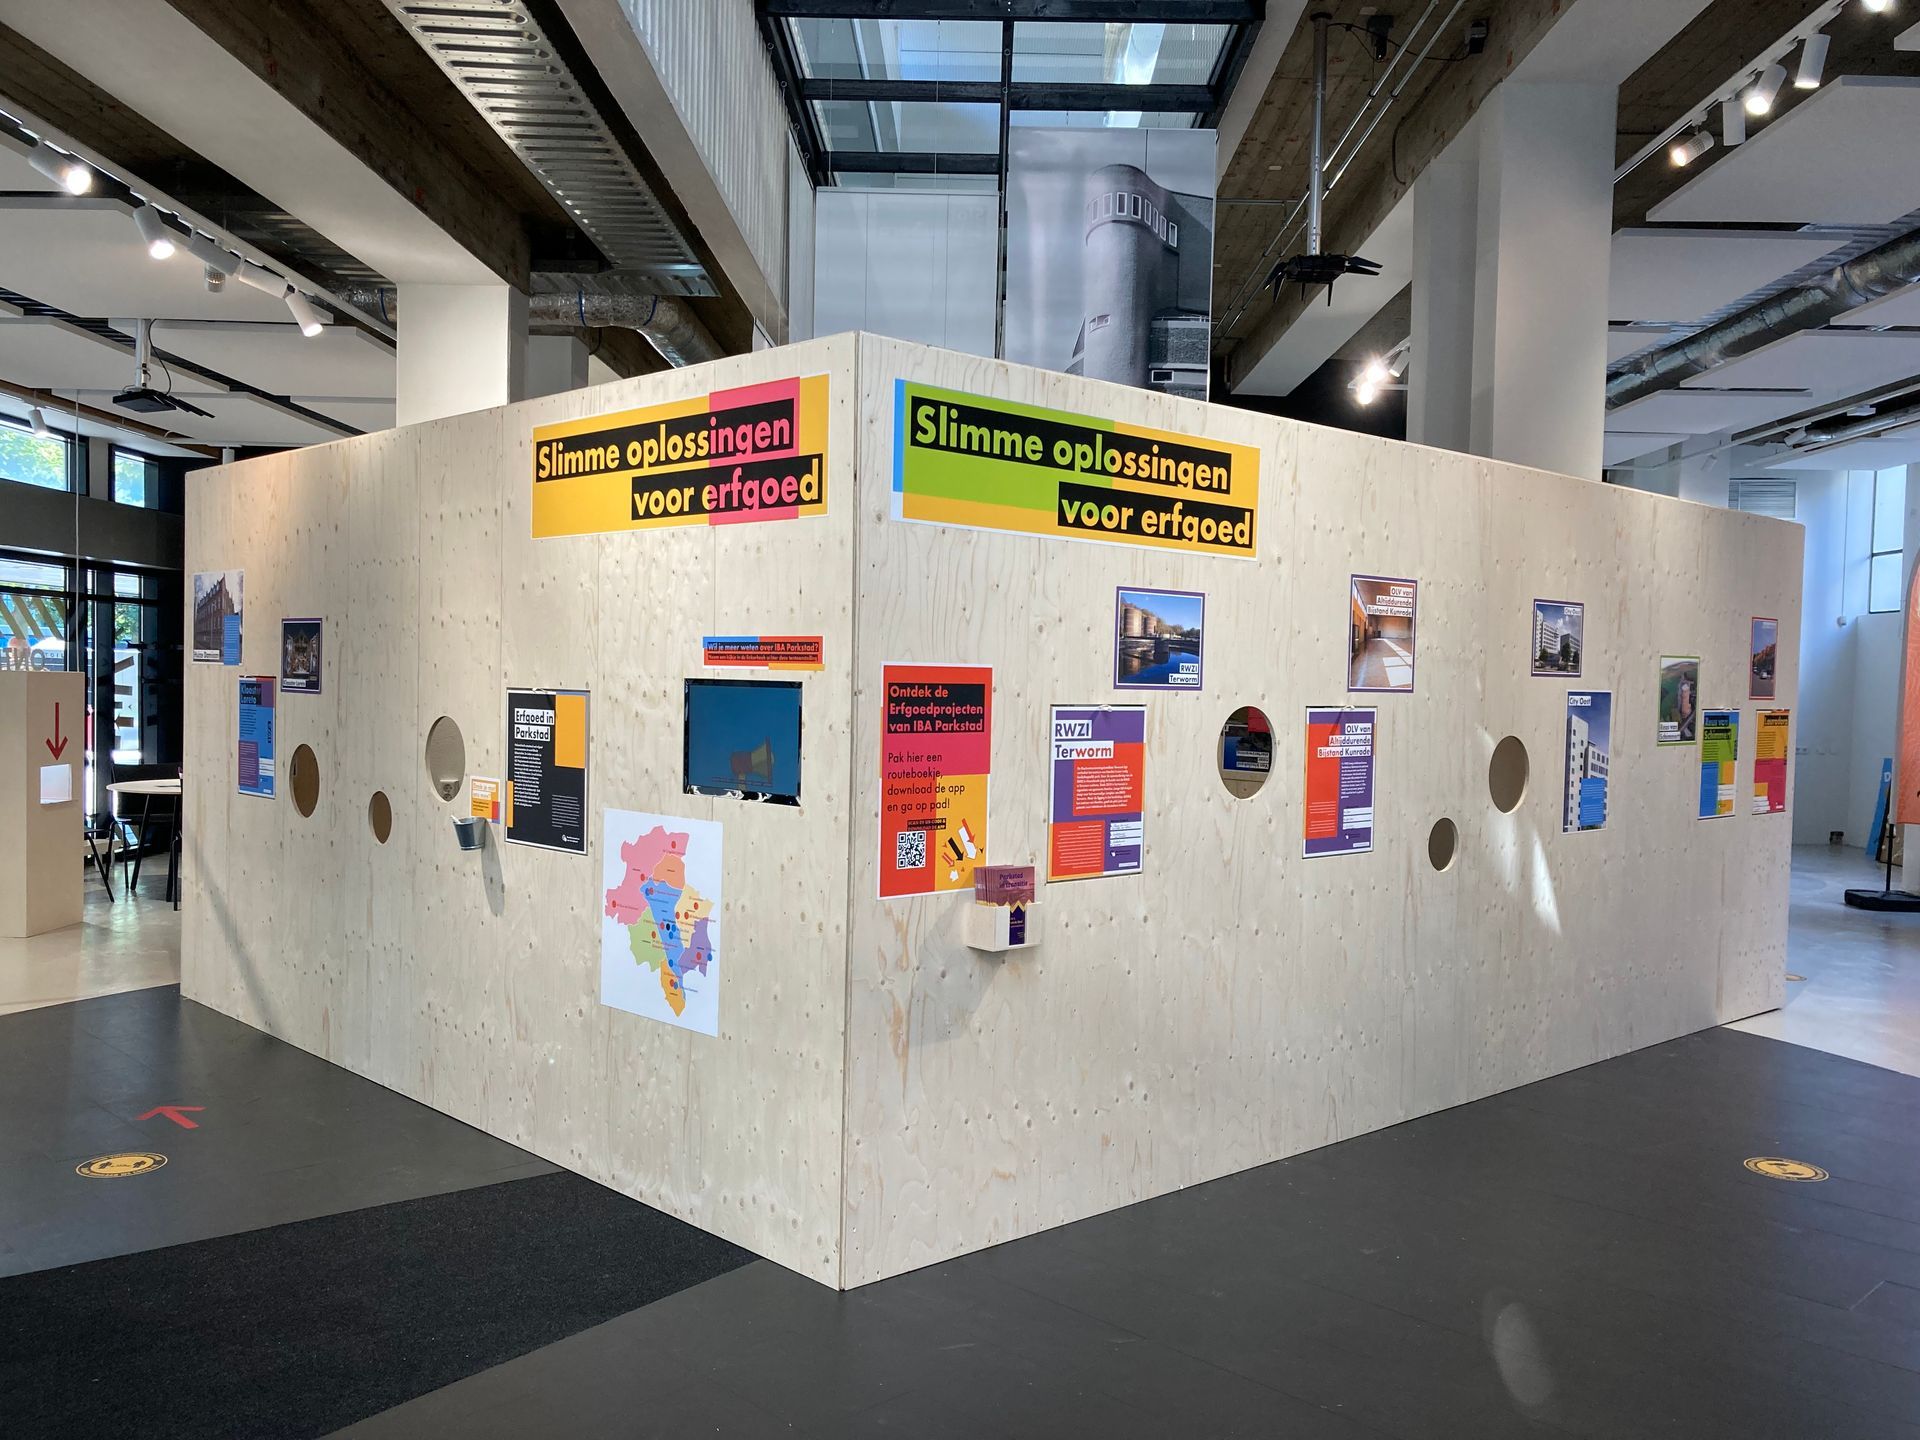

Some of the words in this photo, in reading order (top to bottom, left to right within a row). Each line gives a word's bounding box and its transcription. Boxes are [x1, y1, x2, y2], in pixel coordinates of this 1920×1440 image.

[538, 443, 620, 479] Slimme
[626, 416, 790, 468] oplossingen
[915, 404, 1043, 461] Slimme
[1054, 433, 1228, 490] oplossingen
[634, 486, 695, 516] voor
[702, 458, 819, 511] erfgoed
[1061, 498, 1134, 530] voor
[1142, 502, 1251, 545] erfgoed
[708, 642, 717, 651] Wil
[718, 642, 724, 652] je
[774, 643, 785, 651] IBA
[786, 643, 818, 652] Parkstad?
[1181, 664, 1198, 672] RWZI
[1170, 675, 1198, 683] Terworm
[890, 685, 932, 698] Ontdek
[935, 685, 949, 698] de
[890, 702, 983, 718] Erfgoedprojecten
[516, 710, 545, 724] Erfgoed
[546, 712, 554, 724] in
[889, 723, 910, 732] van
[913, 720, 932, 732] IBA
[935, 719, 983, 731] Parkstad
[1055, 722, 1090, 738] RWZI
[1346, 725, 1359, 733] OLV
[516, 727, 549, 740] Parkstad
[1330, 736, 1371, 745] Altijddurende
[888, 752, 904, 763] Pak
[907, 751, 924, 762] hier
[926, 754, 943, 762] een
[1055, 744, 1112, 759] Terworm
[1318, 748, 1344, 757] Bijstand
[1344, 747, 1371, 756] Kunrade
[888, 767, 943, 780] routeboekje,
[887, 783, 932, 795] download
[935, 783, 946, 793] de
[948, 785, 965, 795] app
[887, 804, 898, 812] en
[901, 803, 913, 814] ga
[916, 803, 927, 813] op
[930, 798, 950, 812] pad!
